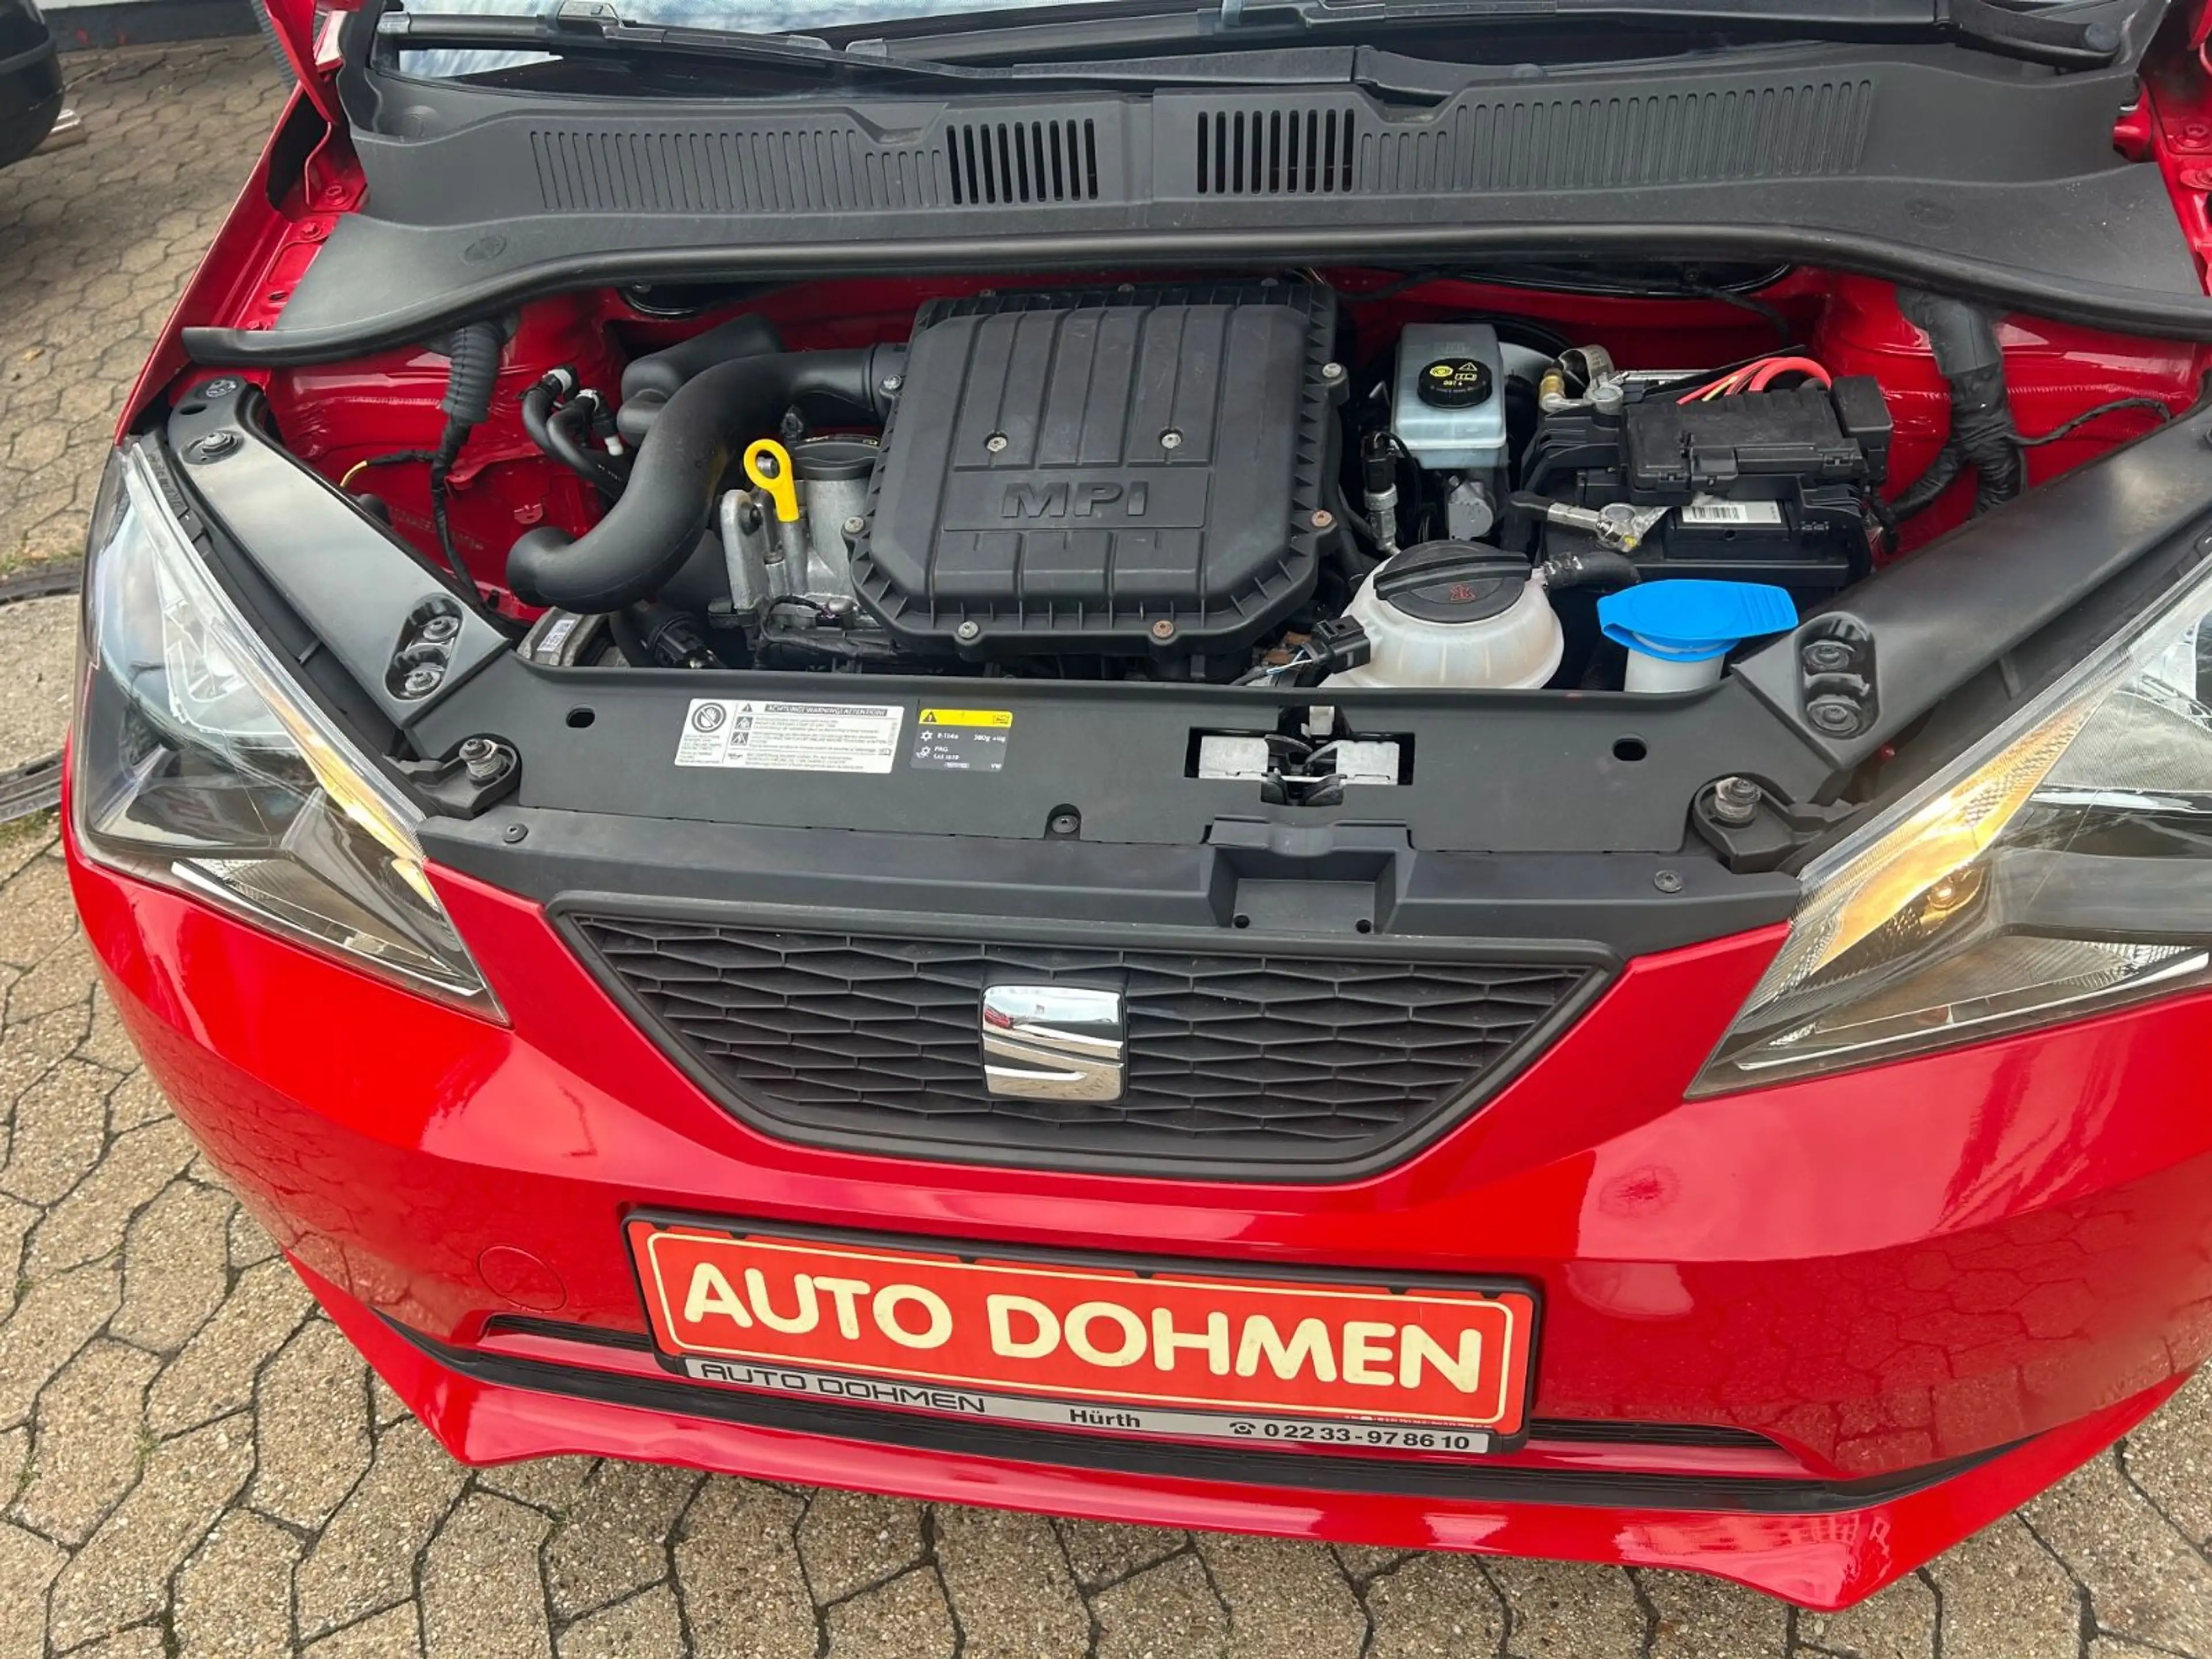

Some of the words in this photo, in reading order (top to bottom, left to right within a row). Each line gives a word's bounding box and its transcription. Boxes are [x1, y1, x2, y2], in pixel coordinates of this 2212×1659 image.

[1002, 481, 1149, 518] MPI
[684, 1262, 953, 1349] AUTO
[986, 1294, 1482, 1393] DOHMEN
[701, 1363, 807, 1390] AUTO
[817, 1377, 986, 1413] DOHMEN
[1069, 1409, 1141, 1429] Hürth
